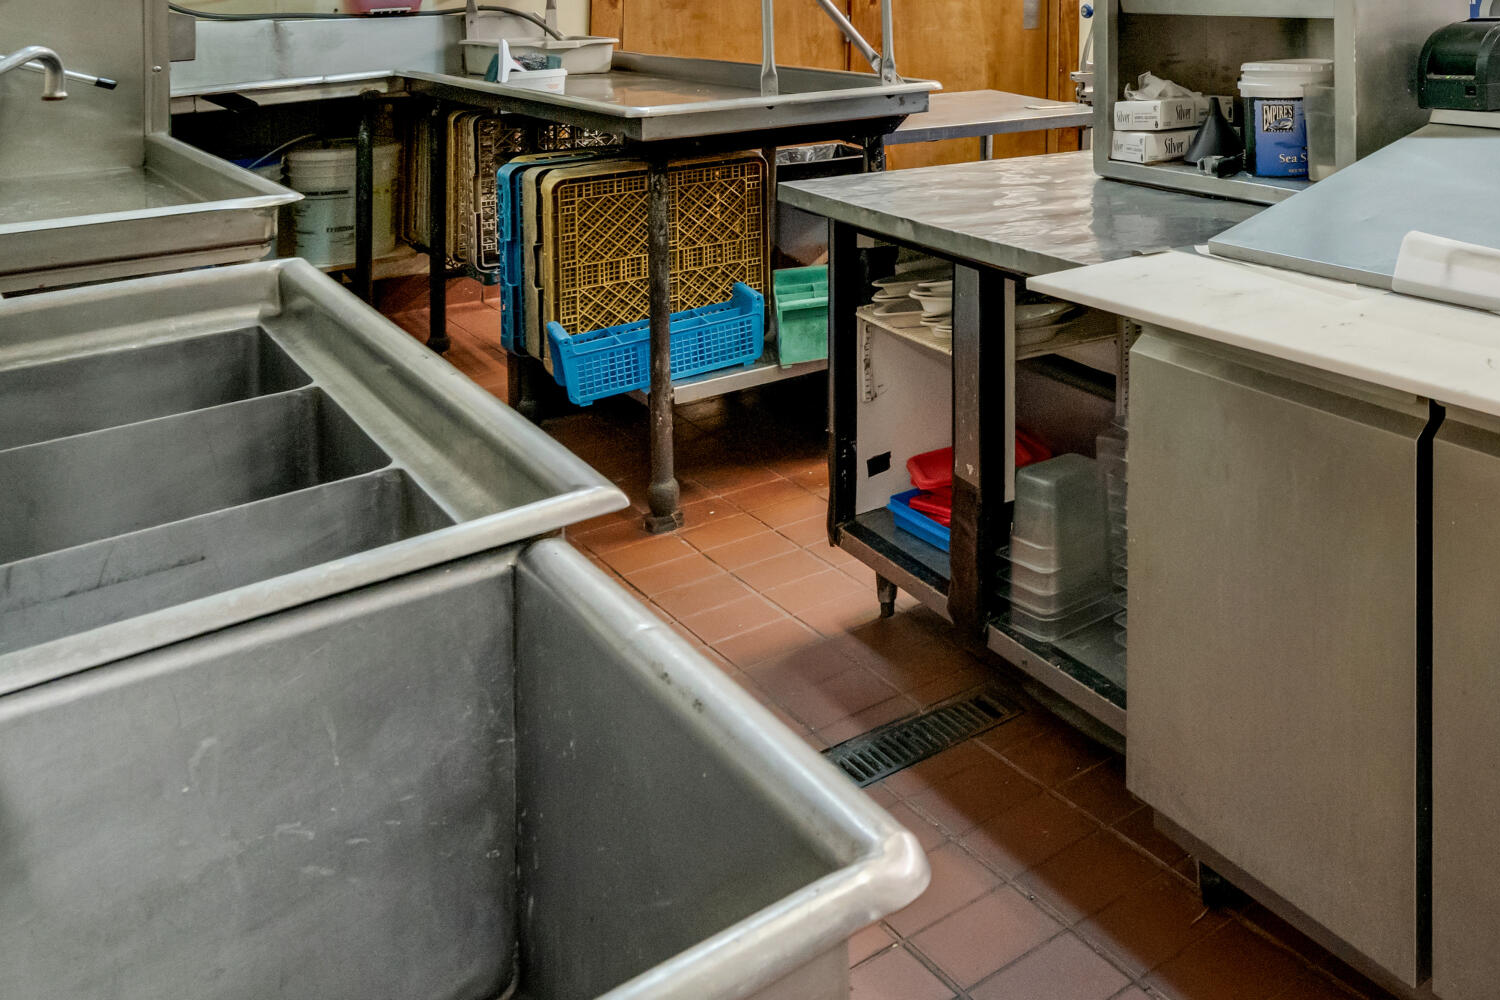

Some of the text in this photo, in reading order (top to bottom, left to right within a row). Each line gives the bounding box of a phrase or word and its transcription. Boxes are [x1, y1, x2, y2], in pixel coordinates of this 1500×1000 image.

[1175, 103, 1192, 120] Silver
[1164, 137, 1184, 154] Silver
[1279, 153, 1297, 163] Sea
